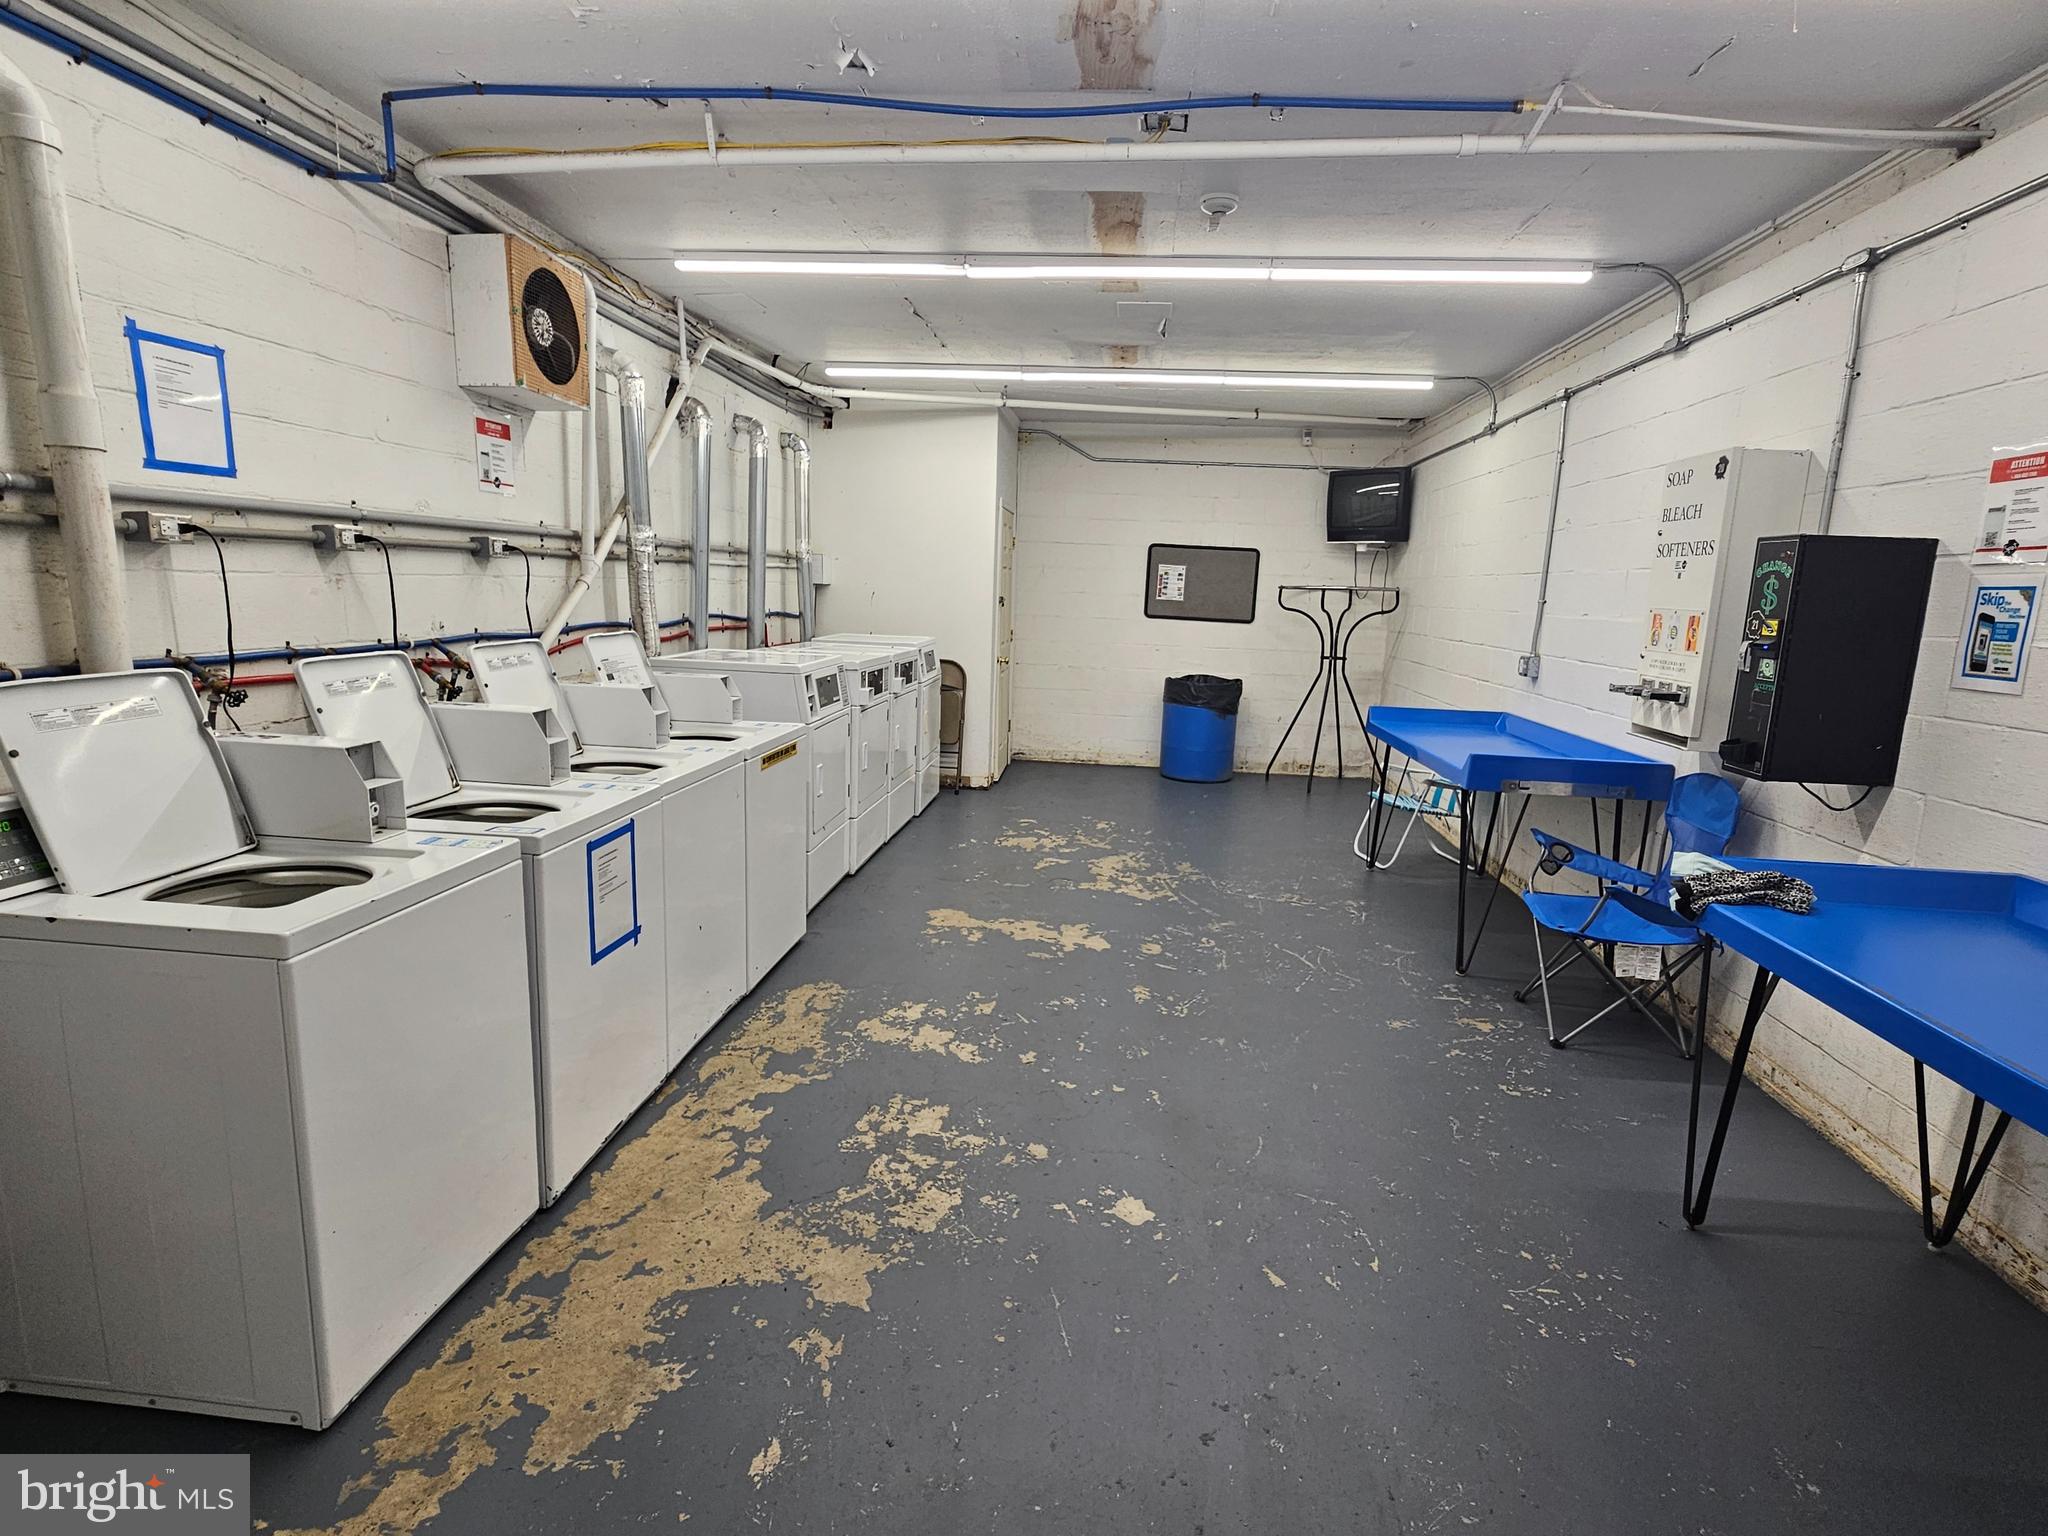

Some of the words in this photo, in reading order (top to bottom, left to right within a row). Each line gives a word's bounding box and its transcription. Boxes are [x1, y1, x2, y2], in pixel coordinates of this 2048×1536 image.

[2010, 456, 2046, 469] ATTENTION
[1667, 469, 1694, 488] SOAP
[1662, 503, 1703, 523] BLEACH
[1657, 540, 1716, 559] SOFTENERS
[1755, 560, 1793, 578] CHANGE
[1980, 592, 2005, 610] Skip
[1751, 619, 1759, 630] 21
